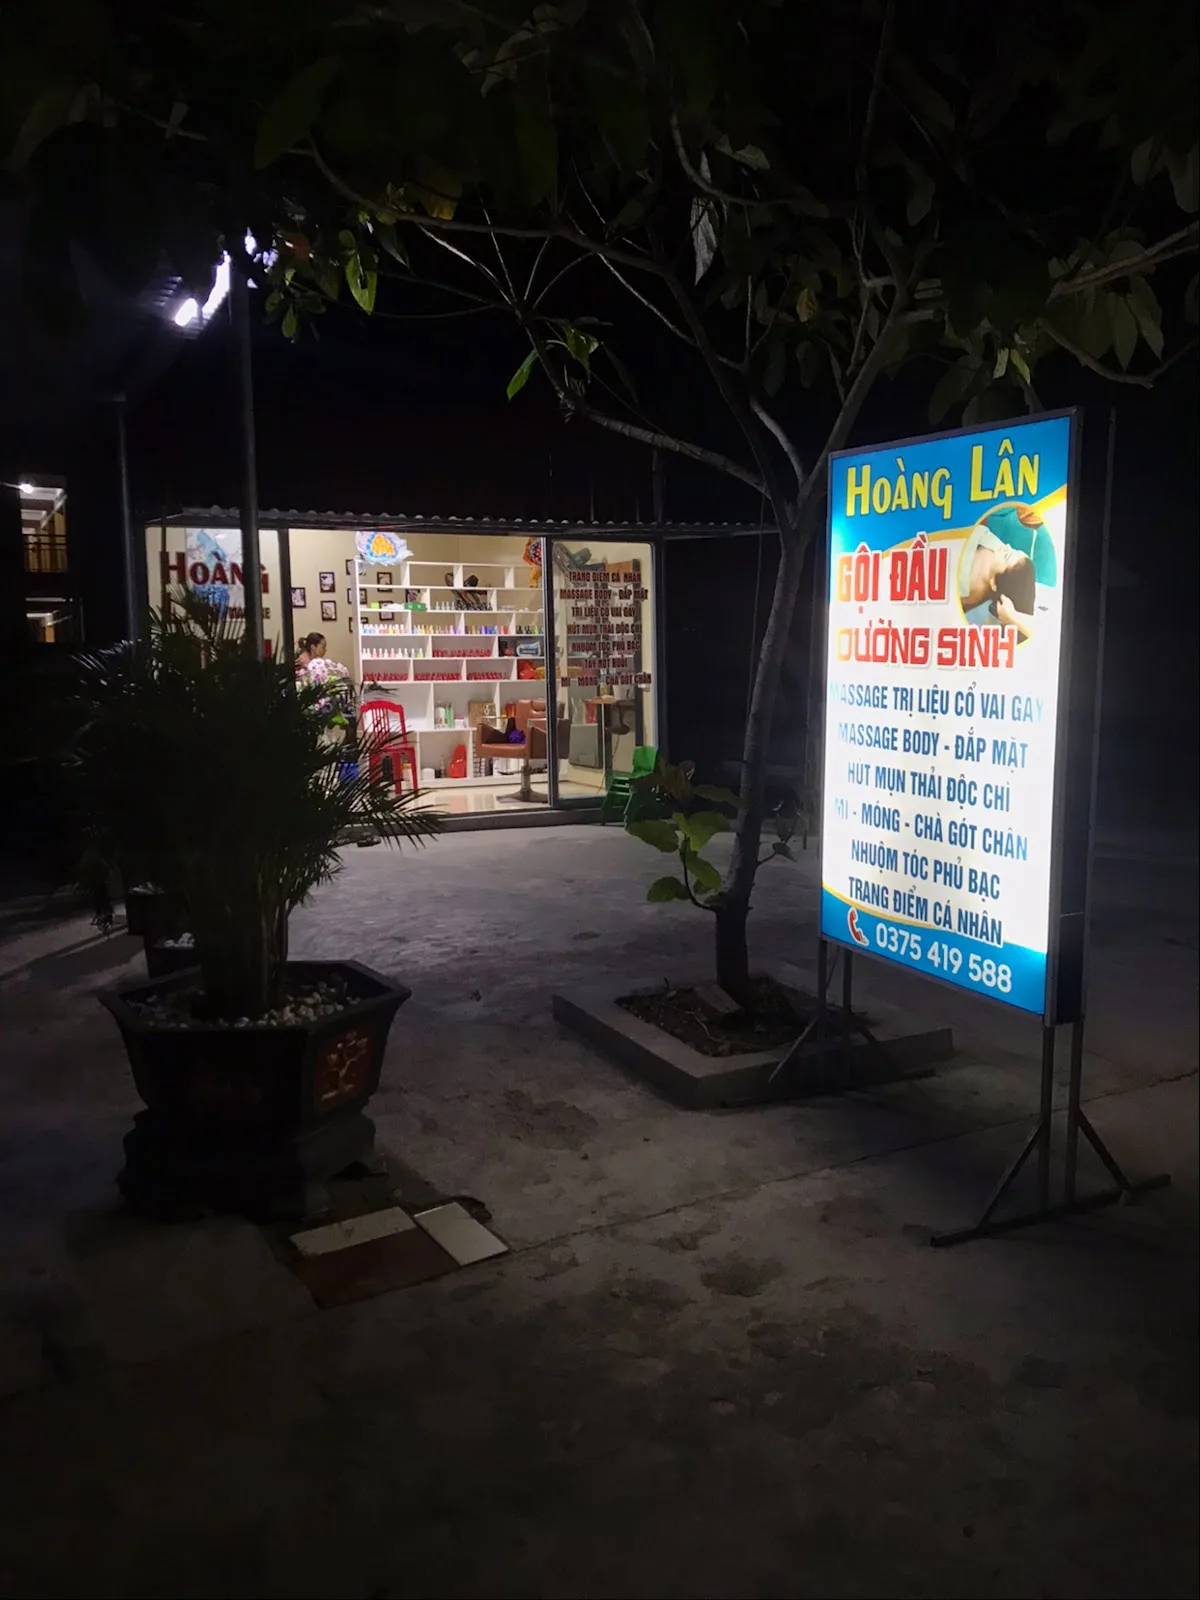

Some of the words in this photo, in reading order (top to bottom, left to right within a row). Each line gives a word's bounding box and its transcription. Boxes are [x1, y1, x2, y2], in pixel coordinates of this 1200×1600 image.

[969, 439, 1040, 502] LÂN
[159, 551, 269, 594] HOÀN
[560, 588, 593, 599] MASSAGE
[594, 588, 612, 599] BODY
[838, 545, 881, 614] GỘI
[889, 534, 948, 601] ĐẦU
[937, 627, 1018, 669] SINH
[893, 686, 913, 717] TRỊ
[918, 684, 950, 720] LIỆU
[954, 681, 977, 717] CỔ
[980, 692, 1005, 720] VAI
[838, 722, 898, 751] MASSAGE
[903, 729, 940, 756] BODY
[955, 726, 987, 763] ĐẮP
[992, 736, 1029, 774] MẶT
[875, 766, 906, 796] MỤN
[910, 766, 942, 800] THẢI
[946, 773, 978, 810] ĐỘC
[862, 800, 900, 833] MÓNG
[914, 812, 943, 843] CHÀ
[948, 817, 977, 850] GÓT
[982, 827, 1028, 861] CHÂN
[852, 839, 898, 873] NHUỘM
[902, 848, 929, 880] TÓC
[933, 856, 963, 890] PHỦ
[968, 868, 1001, 902] BẠC
[848, 876, 889, 910] TRANG
[893, 885, 928, 922] ĐIỂM
[933, 899, 953, 931] CÁ
[957, 909, 1003, 946] NHÂN
[876, 922, 922, 961] 0375
[927, 941, 963, 975] 419
[968, 953, 1012, 993] 588
